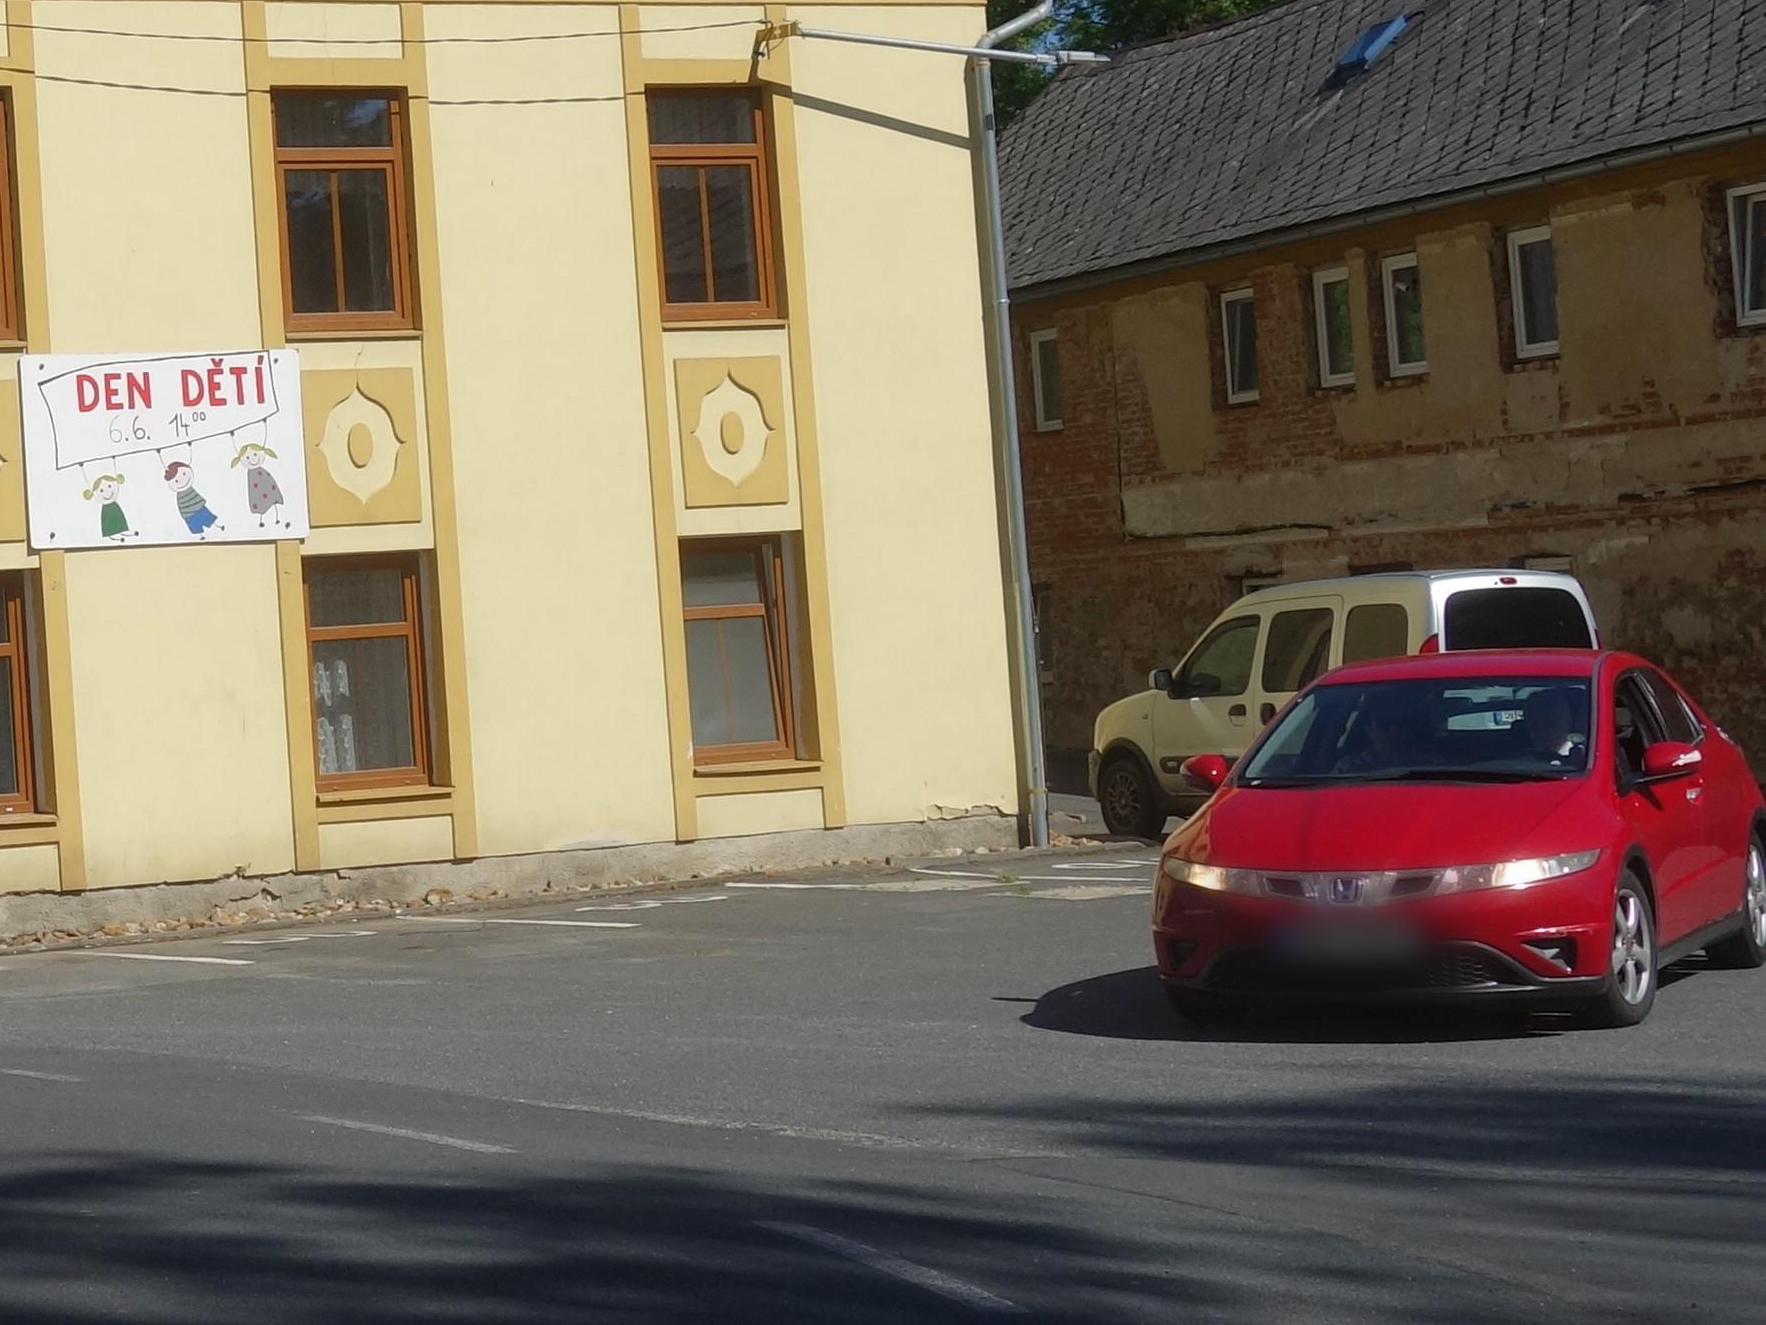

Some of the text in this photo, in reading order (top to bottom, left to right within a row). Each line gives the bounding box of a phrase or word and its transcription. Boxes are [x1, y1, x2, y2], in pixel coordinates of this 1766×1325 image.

[75, 355, 265, 412] DEN DĚTÍ
[108, 414, 151, 443] 6.6.
